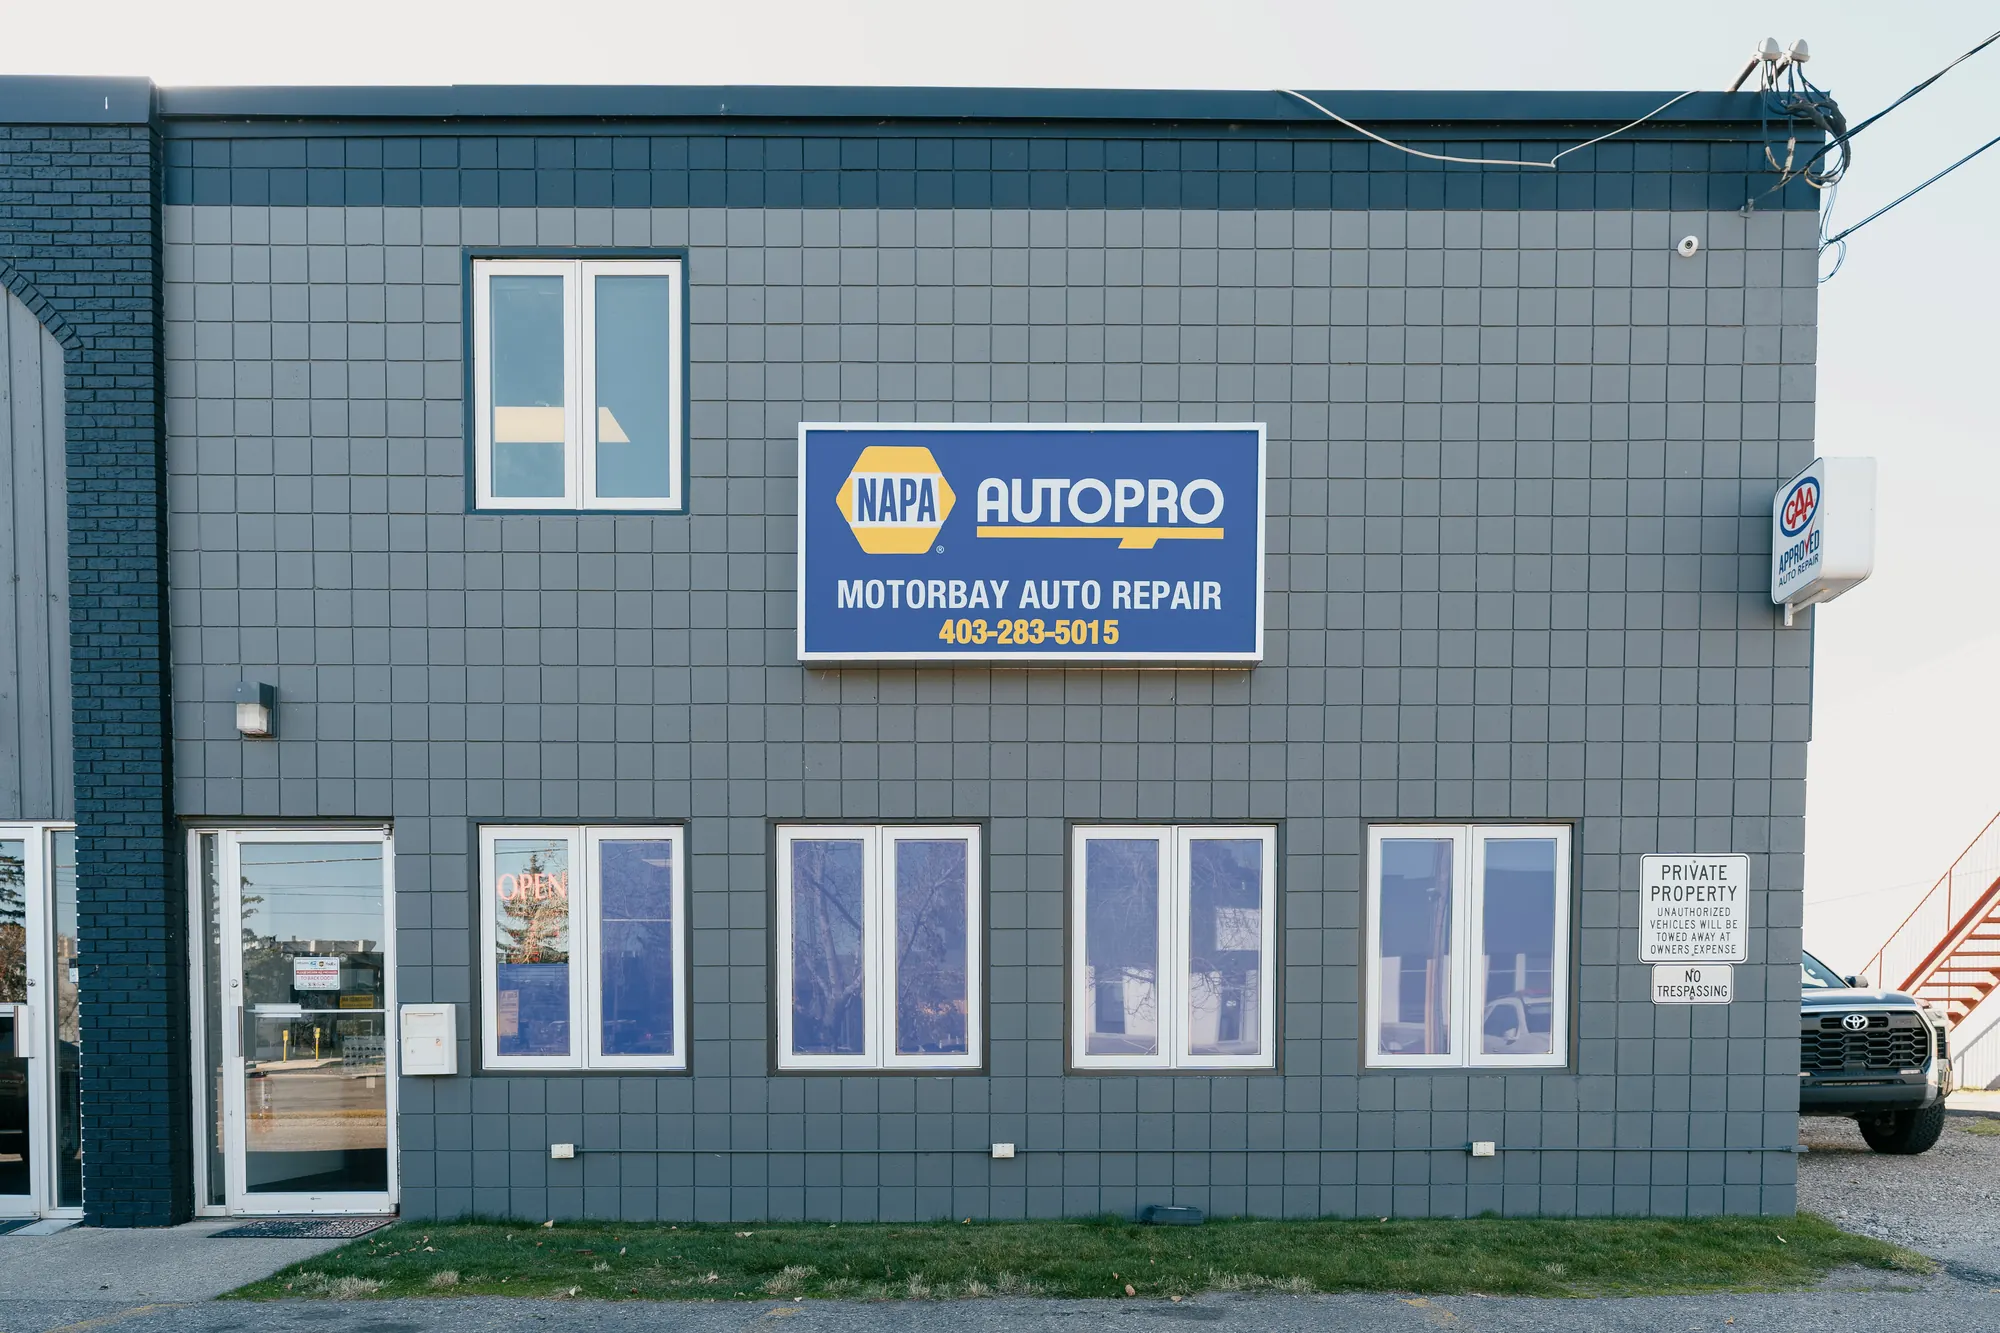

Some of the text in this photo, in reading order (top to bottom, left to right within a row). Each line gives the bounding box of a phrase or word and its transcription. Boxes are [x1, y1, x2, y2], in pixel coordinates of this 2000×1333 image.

[857, 477, 1225, 524] NAPA AUTOPRO
[1785, 487, 1814, 529] CAA
[1779, 529, 1820, 575] APPROVED
[1778, 553, 1819, 587] AUTO REPAIR
[837, 579, 1222, 610] MOTORBAY AUTO REPAIR
[938, 618, 1120, 645] 403-283-5015
[1661, 864, 1728, 880] PRIVATE
[497, 872, 567, 900] OPEN
[1651, 885, 1737, 902] PROPERTY
[1657, 907, 1731, 917] UNAUTHORIZED
[1650, 919, 1738, 930] VEHICLES WILL BE
[1656, 932, 1731, 942] TOWED AWAY AT
[1650, 944, 1737, 955] OWNERS EXPENSE
[1684, 970, 1701, 982] NO
[1656, 985, 1728, 997] TRESPASSING
